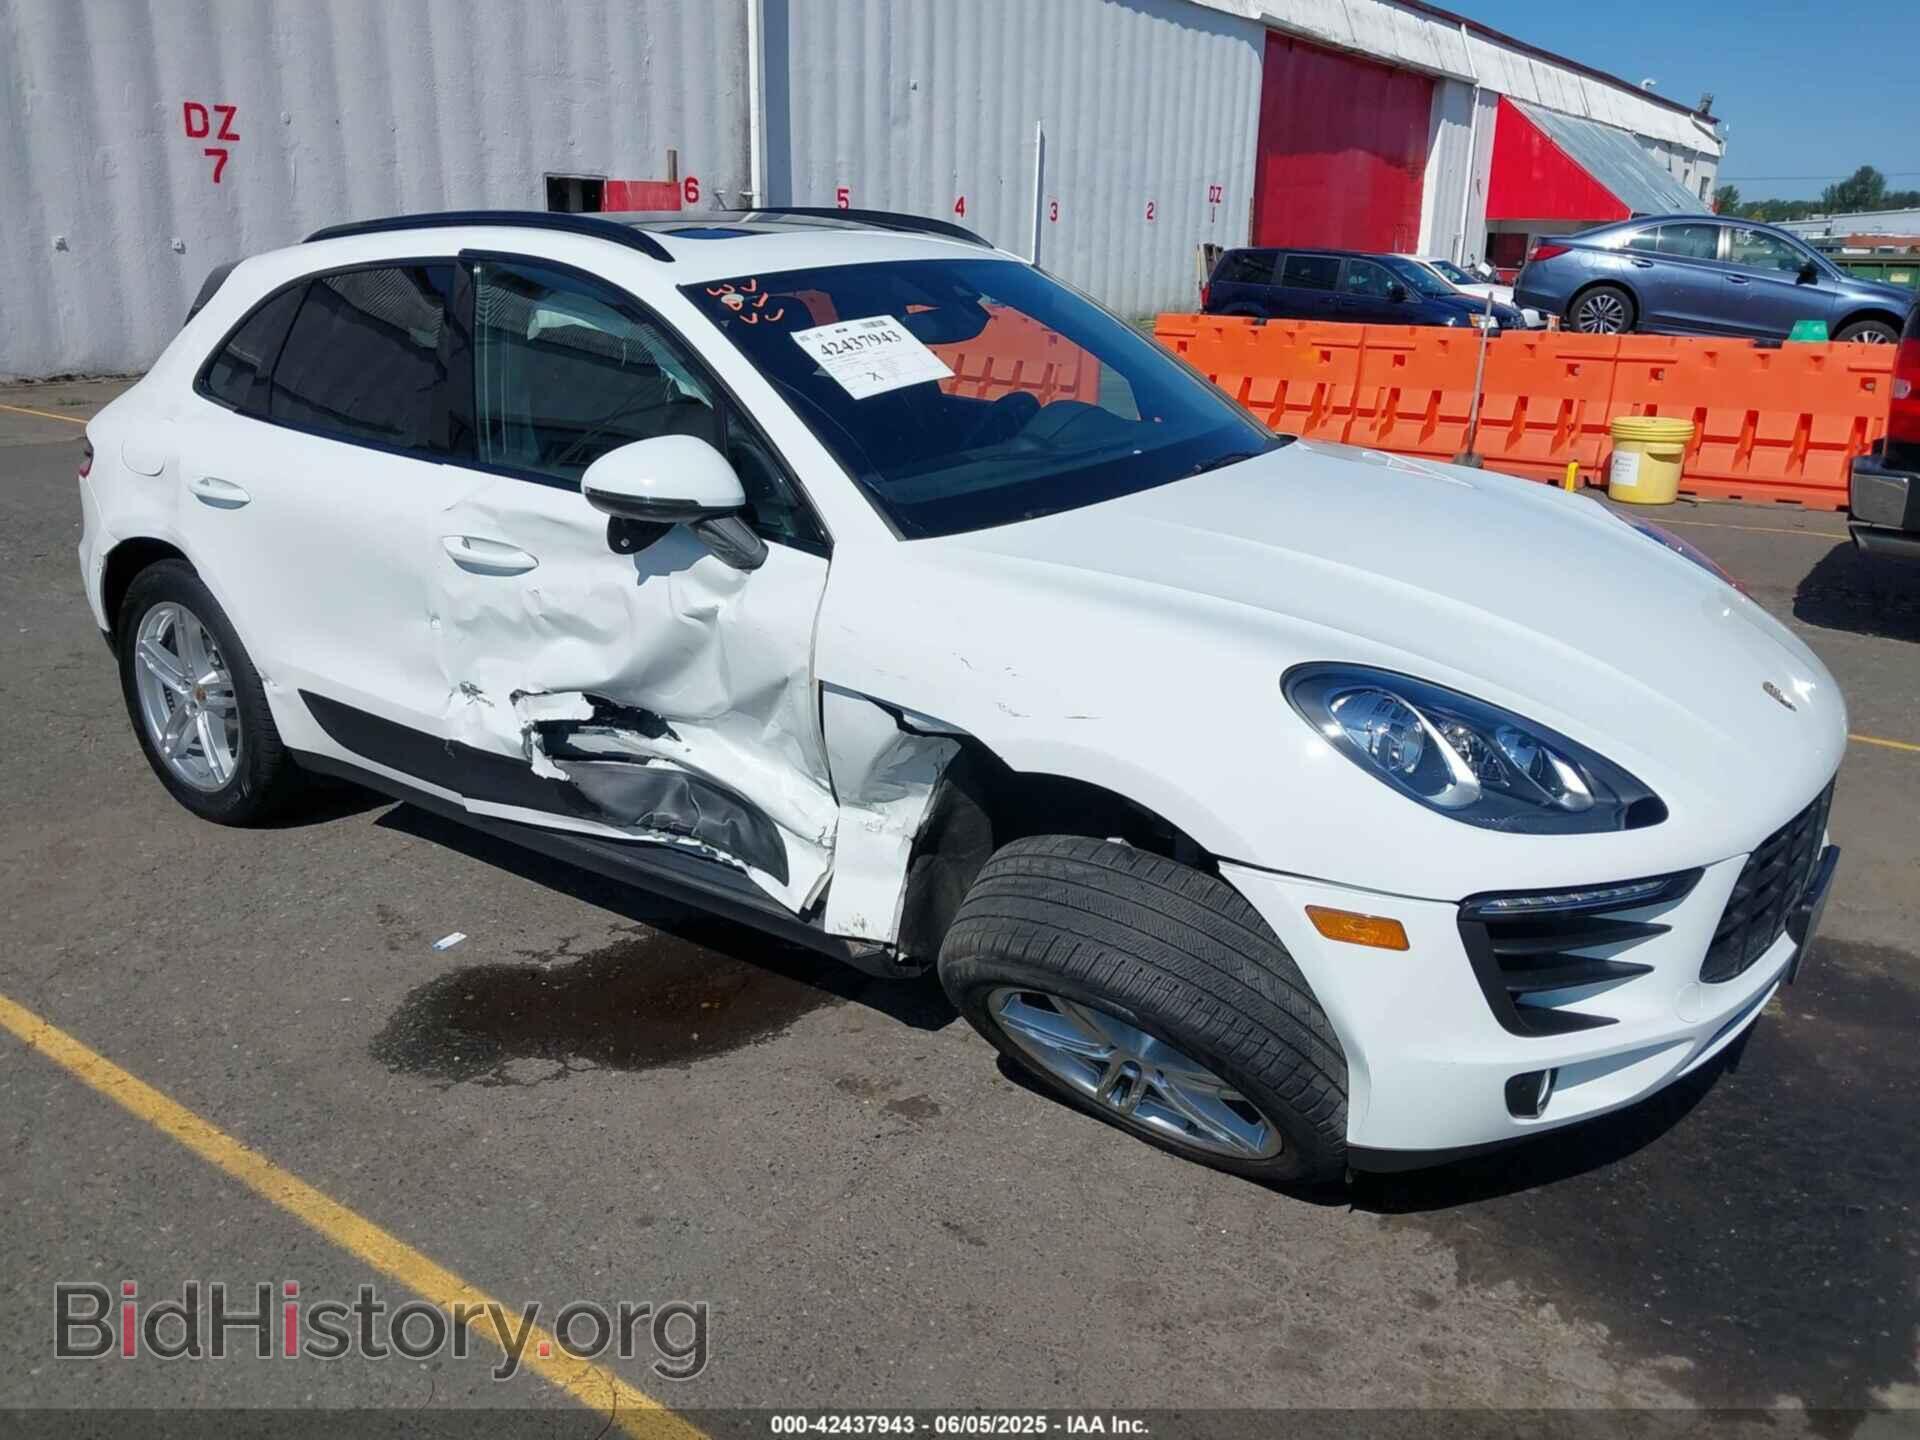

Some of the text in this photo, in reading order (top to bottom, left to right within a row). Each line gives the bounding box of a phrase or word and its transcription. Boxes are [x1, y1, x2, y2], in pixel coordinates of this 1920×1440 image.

[183, 102, 240, 141] DZ
[204, 148, 228, 184] 7
[684, 176, 699, 203] 6
[837, 188, 850, 210] 5
[1209, 185, 1222, 203] DZ
[954, 196, 965, 218] 4
[1050, 202, 1059, 222] 3
[1146, 201, 1155, 220] 2
[820, 330, 902, 355] 42437943
